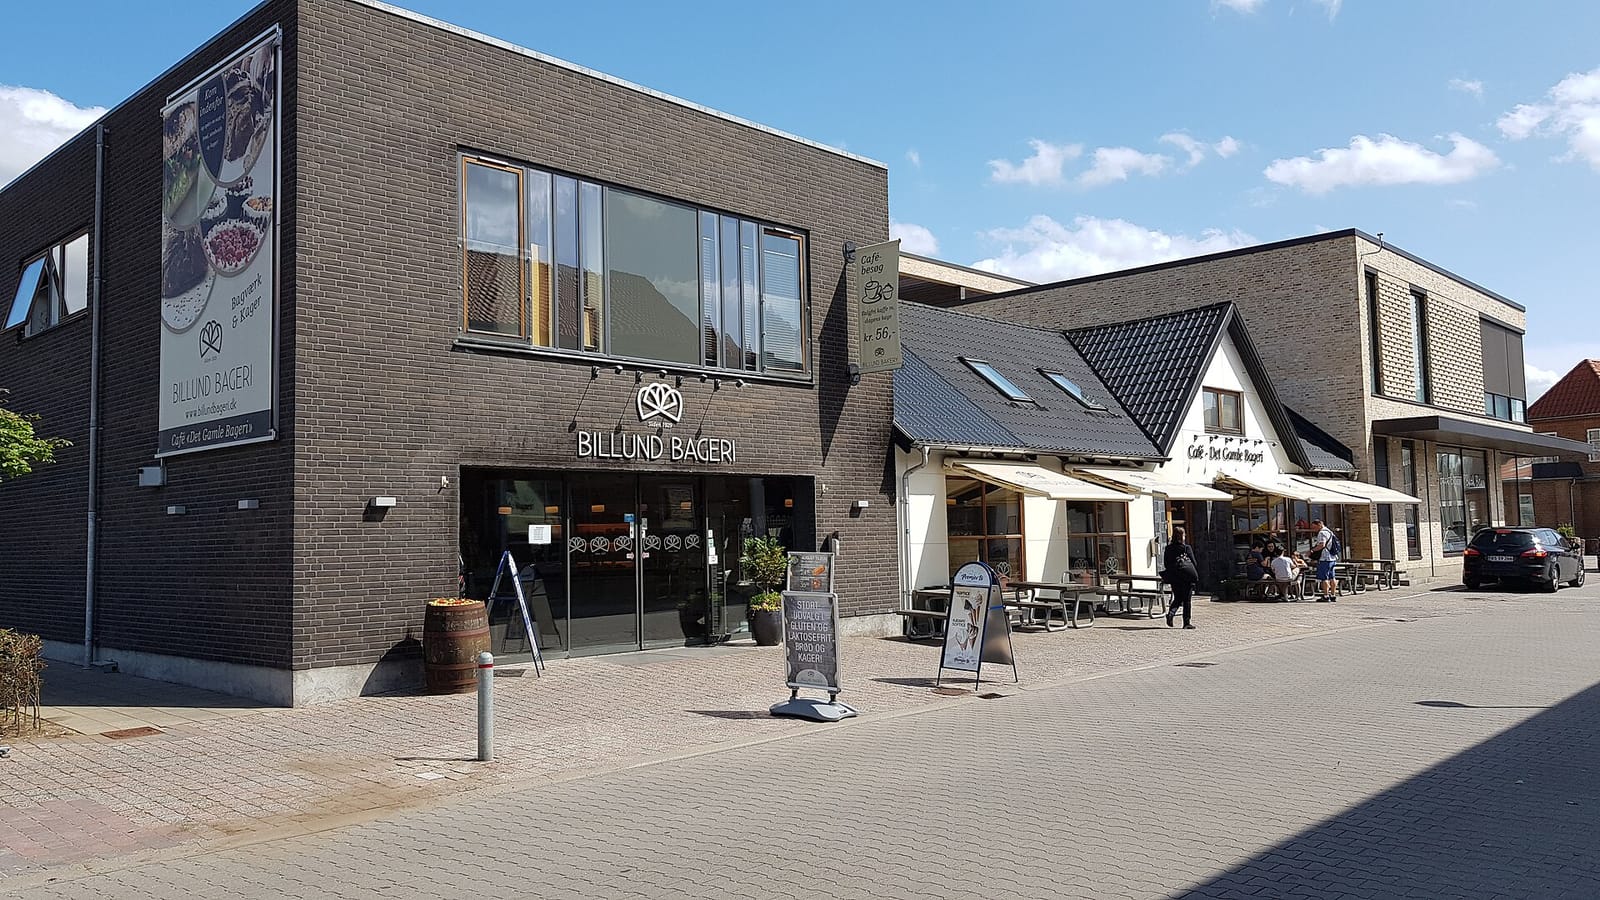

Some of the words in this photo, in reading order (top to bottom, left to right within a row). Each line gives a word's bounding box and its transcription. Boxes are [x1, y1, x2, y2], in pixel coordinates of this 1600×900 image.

[204, 86, 217, 100] Kom
[200, 96, 224, 117] indenfor
[231, 273, 262, 310] Bagværk
[232, 316, 239, 328] &
[240, 295, 262, 324] Kager
[864, 333, 874, 342] kr.
[876, 326, 896, 340] 56,-
[172, 374, 211, 404] BILLUND
[215, 363, 253, 394] BAGERI
[184, 397, 238, 420] www.billundbageri.dk
[171, 432, 185, 448] Café
[202, 425, 224, 441] Gamle
[578, 430, 663, 460] BILLUND
[672, 437, 736, 462] BAGERI
[1188, 444, 1204, 459] Café
[1209, 446, 1221, 460] Det
[1222, 448, 1243, 462] Gamle
[1244, 450, 1264, 466] Bageri
[793, 611, 820, 620] UDVALG
[797, 600, 818, 610] STORT
[818, 623, 828, 632] OG
[795, 642, 814, 652] BRØD
[815, 644, 825, 653] OG
